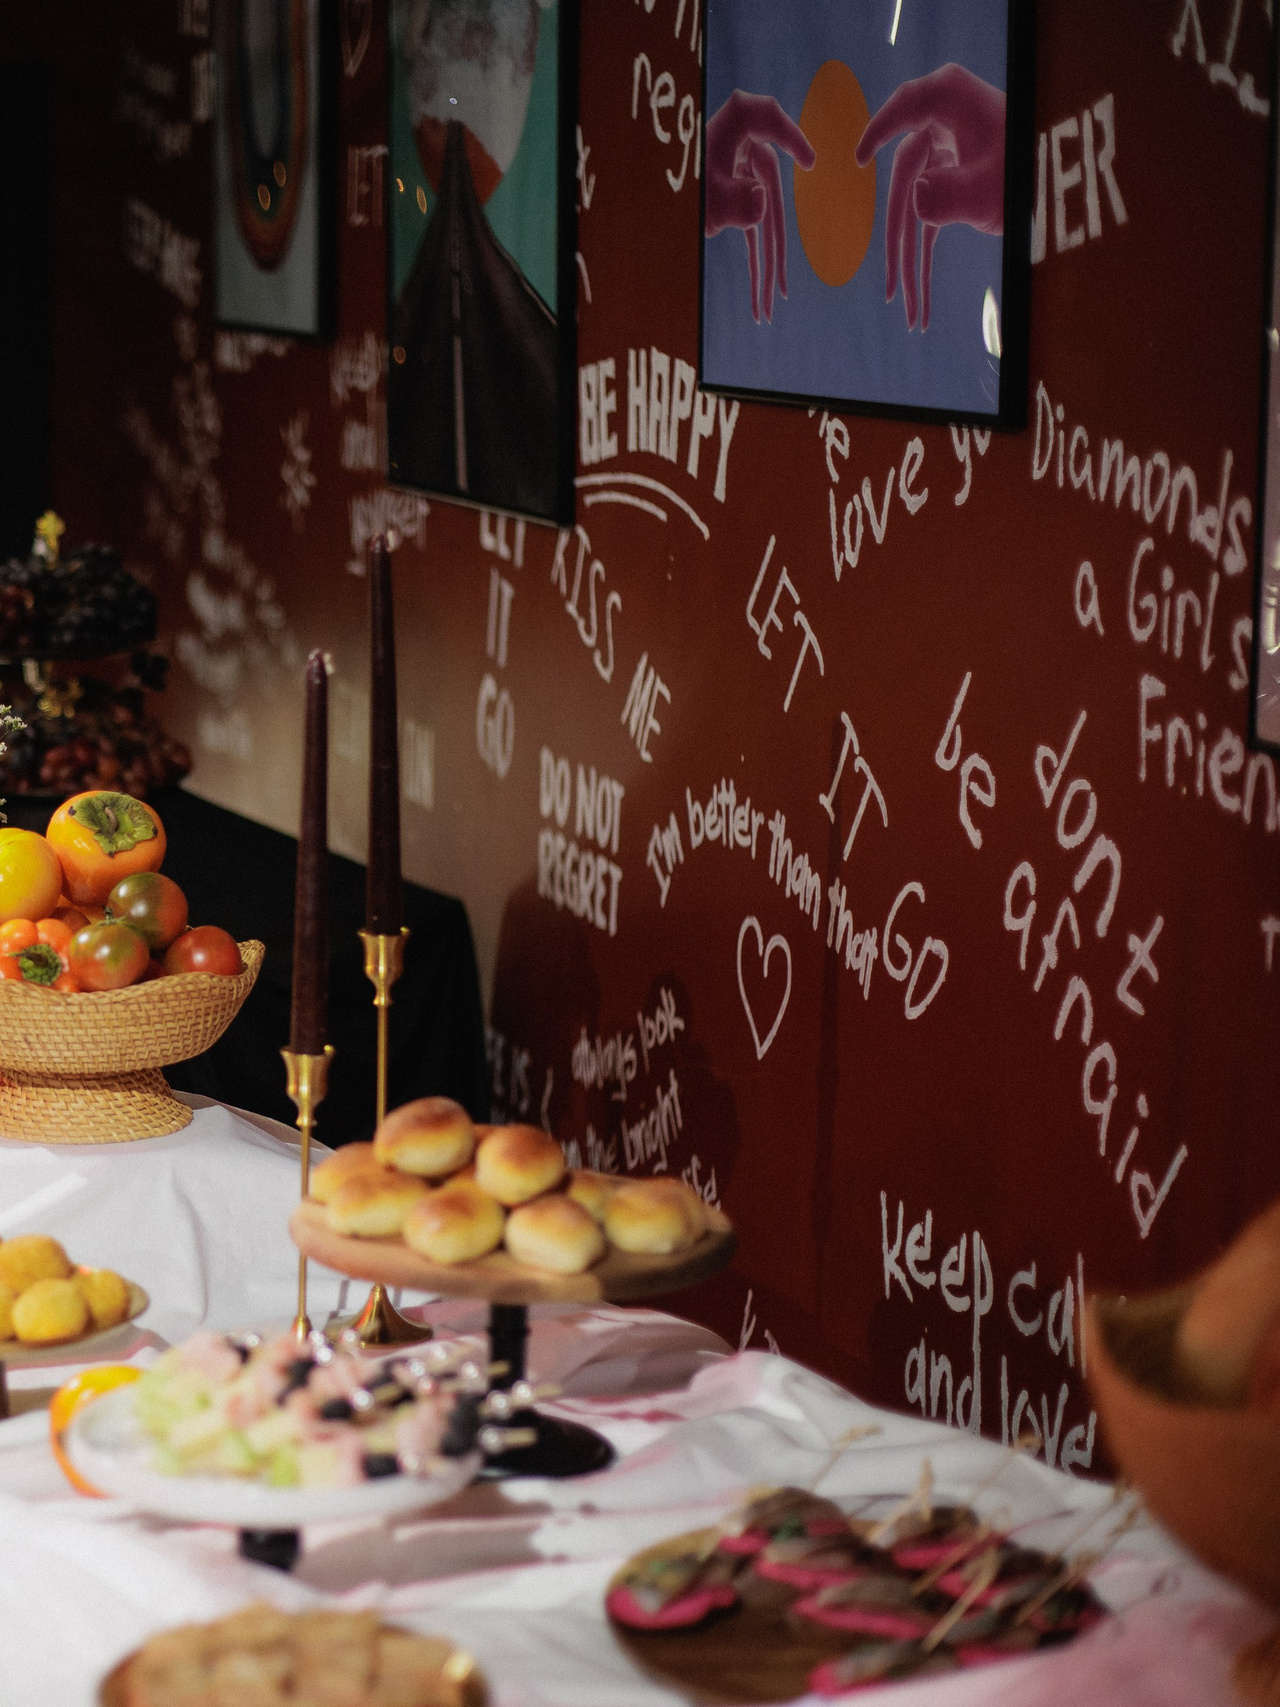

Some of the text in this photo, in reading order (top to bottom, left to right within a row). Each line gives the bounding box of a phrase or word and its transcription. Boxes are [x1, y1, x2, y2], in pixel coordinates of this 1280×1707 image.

[578, 345, 741, 504] BE HAPPY
[1032, 379, 1252, 578] Diamonds
[829, 436, 929, 582] love
[486, 566, 515, 669] IT
[551, 525, 622, 684] KISS
[745, 534, 825, 713] LET
[1075, 560, 1105, 636] a
[477, 671, 516, 780] GO
[621, 651, 672, 764] ME
[935, 672, 995, 850] be
[1140, 673, 1280, 833] Frien
[540, 745, 571, 828] DO
[576, 762, 626, 856] NOT
[819, 711, 889, 863] IT
[537, 826, 623, 937] REGRET
[686, 776, 764, 860] better
[768, 809, 821, 932] than
[882, 881, 949, 1020] GO
[636, 986, 686, 1075] look
[621, 1066, 683, 1175] bright
[1008, 1252, 1087, 1379] cal
[905, 1337, 981, 1436] and
